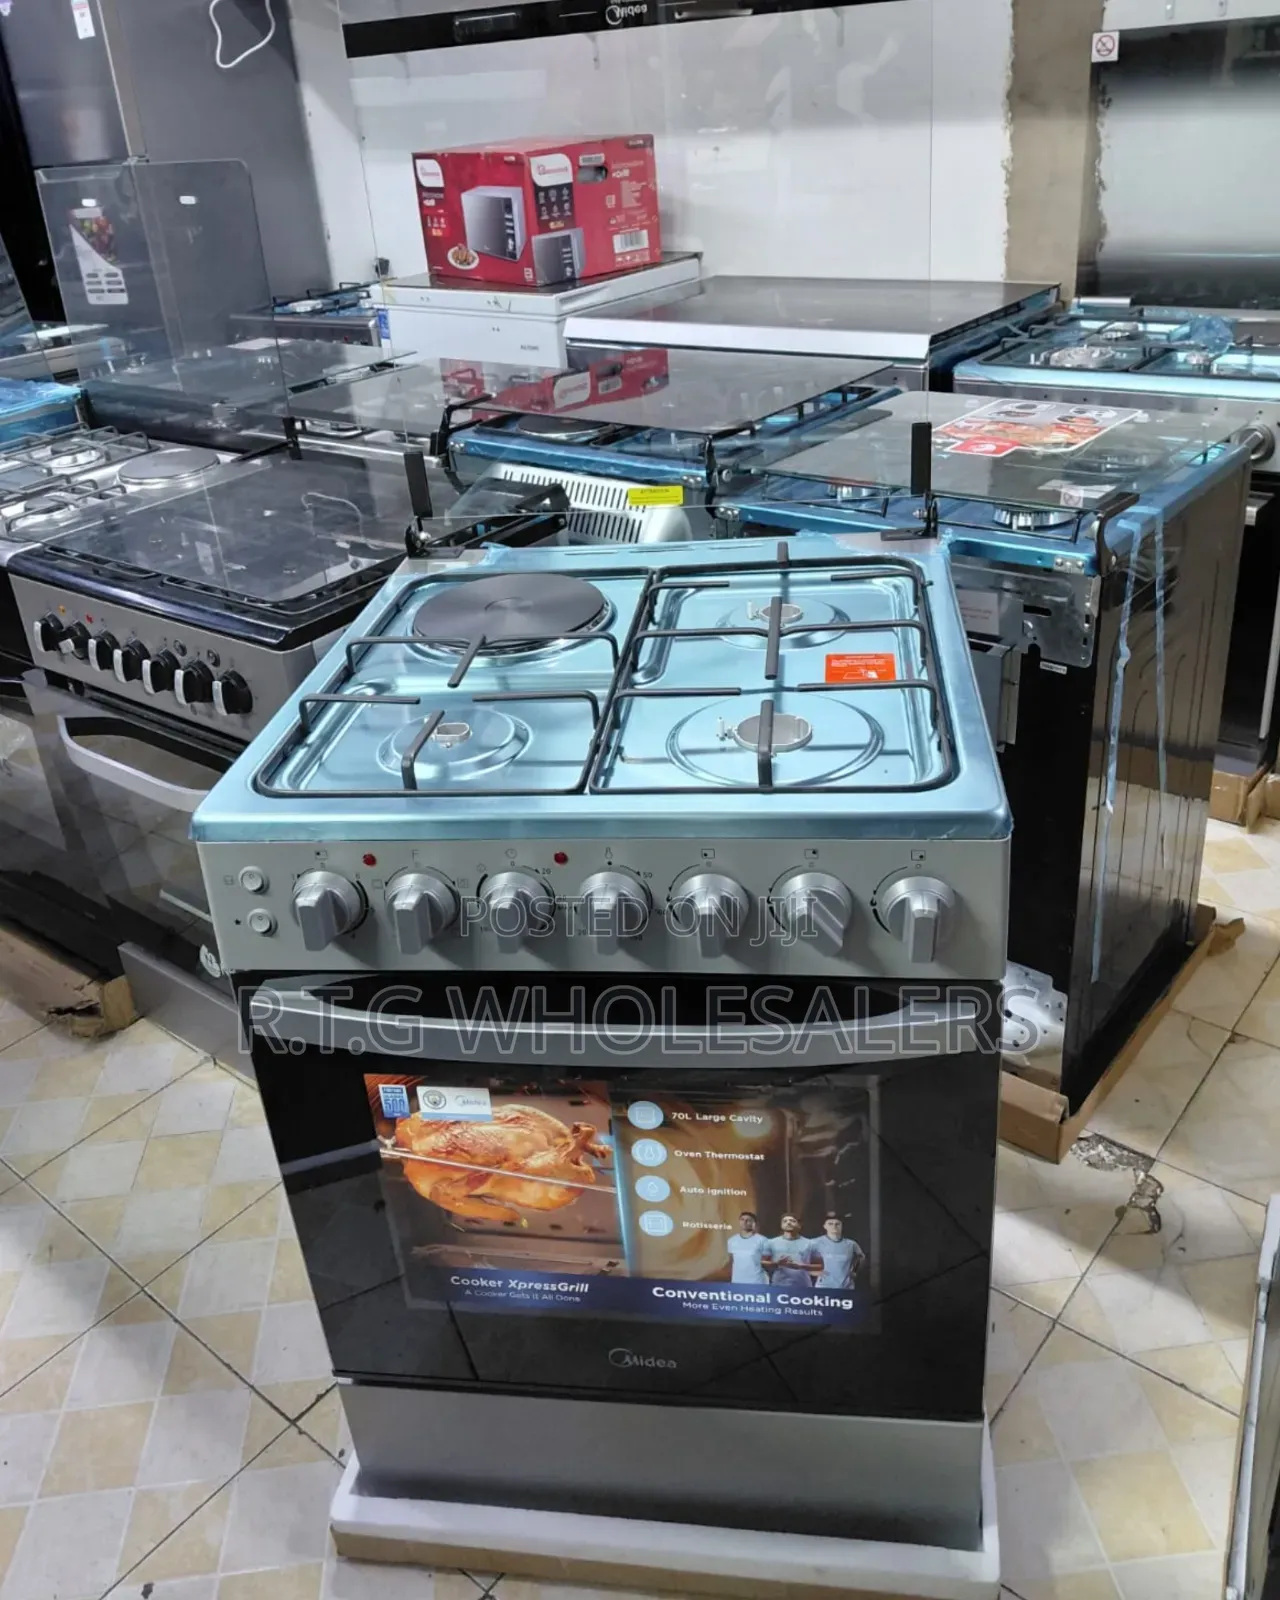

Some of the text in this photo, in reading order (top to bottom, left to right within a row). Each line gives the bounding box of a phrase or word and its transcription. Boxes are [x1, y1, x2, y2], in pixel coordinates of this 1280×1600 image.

[671, 1111, 764, 1125] 70L Large Cavity
[673, 1150, 766, 1161] Oven Thermostat
[679, 1185, 705, 1195] Auto
[682, 1221, 733, 1231] Rotisserie
[450, 1275, 590, 1293] Cooker XpressGrill
[509, 1290, 531, 1300] Gets
[541, 1293, 554, 1301] All
[555, 1294, 581, 1303] Done
[651, 1286, 854, 1311] Conventional Cooking
[682, 1301, 824, 1317] More Even Heating Results
[608, 1347, 678, 1369] Midea
